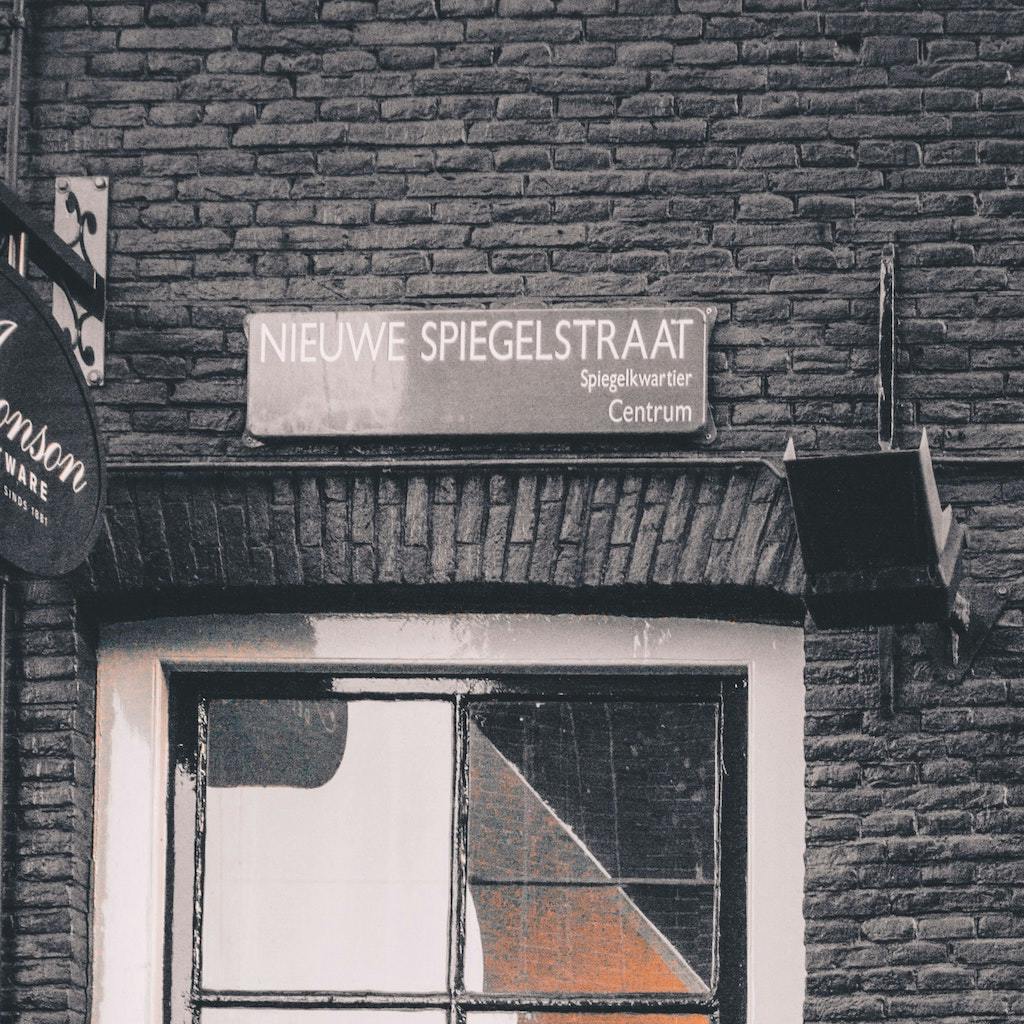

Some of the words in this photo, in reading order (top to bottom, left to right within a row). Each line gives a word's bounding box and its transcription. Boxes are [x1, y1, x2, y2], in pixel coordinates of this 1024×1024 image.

[260, 321, 406, 362] NIEUWE
[420, 319, 694, 362] SPIEGELSTRAAT
[580, 368, 693, 393] Spiegelkwartier
[608, 398, 692, 422] Centrum
[0, 447, 48, 502] WARE
[4, 485, 28, 511] SINDS
